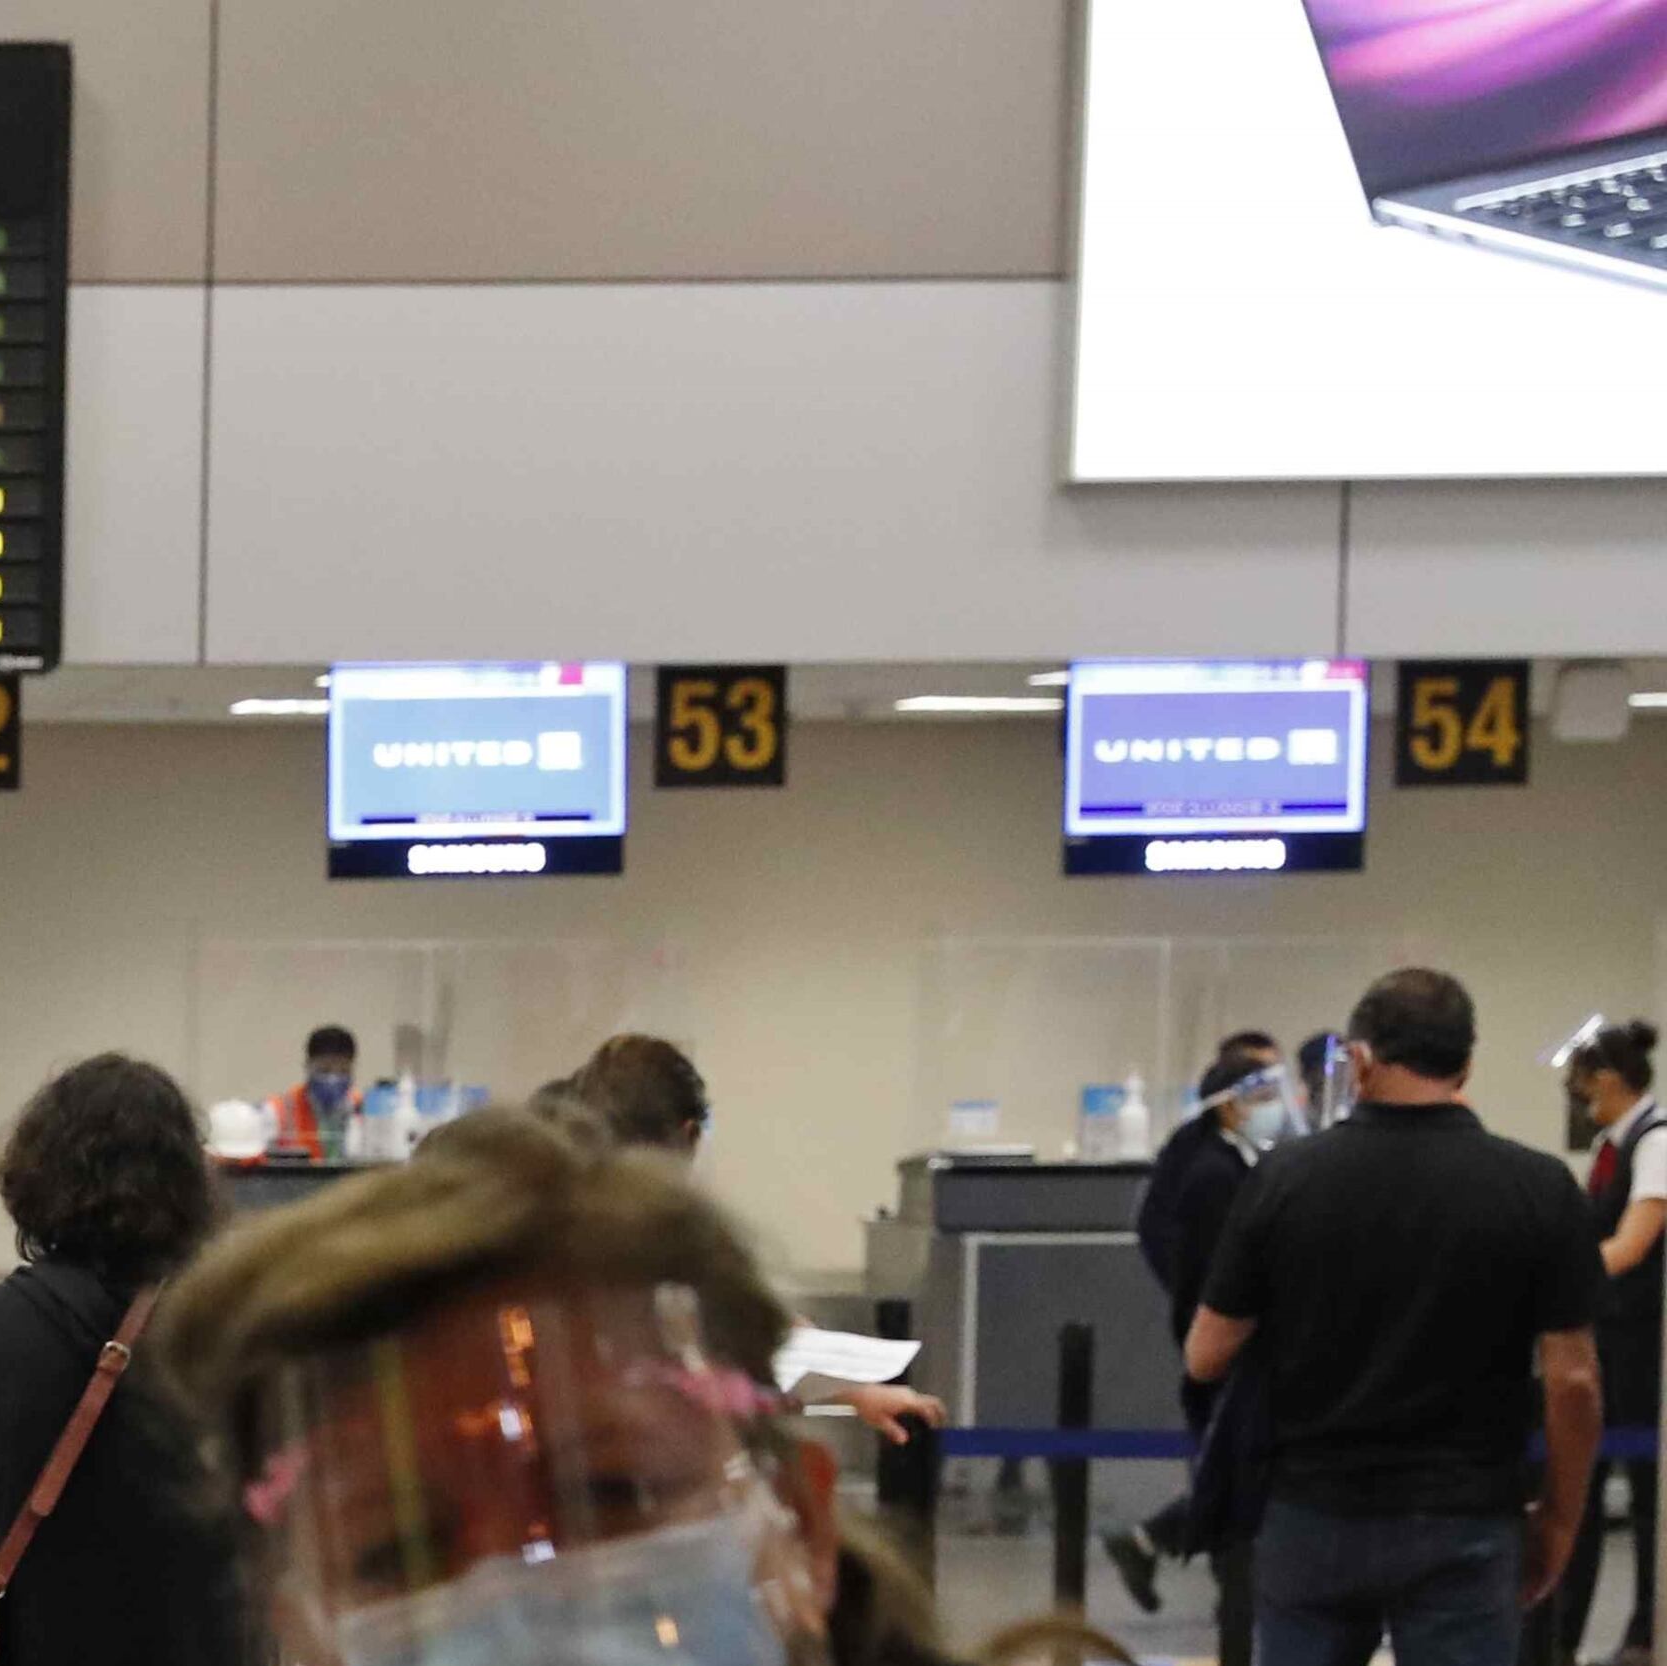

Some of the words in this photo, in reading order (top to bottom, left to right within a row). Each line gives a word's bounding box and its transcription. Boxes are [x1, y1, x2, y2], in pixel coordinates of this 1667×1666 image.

[668, 679, 777, 772] 53
[1095, 737, 1280, 763] UNITED
[1410, 677, 1522, 770] 54
[373, 740, 533, 768] UNITED
